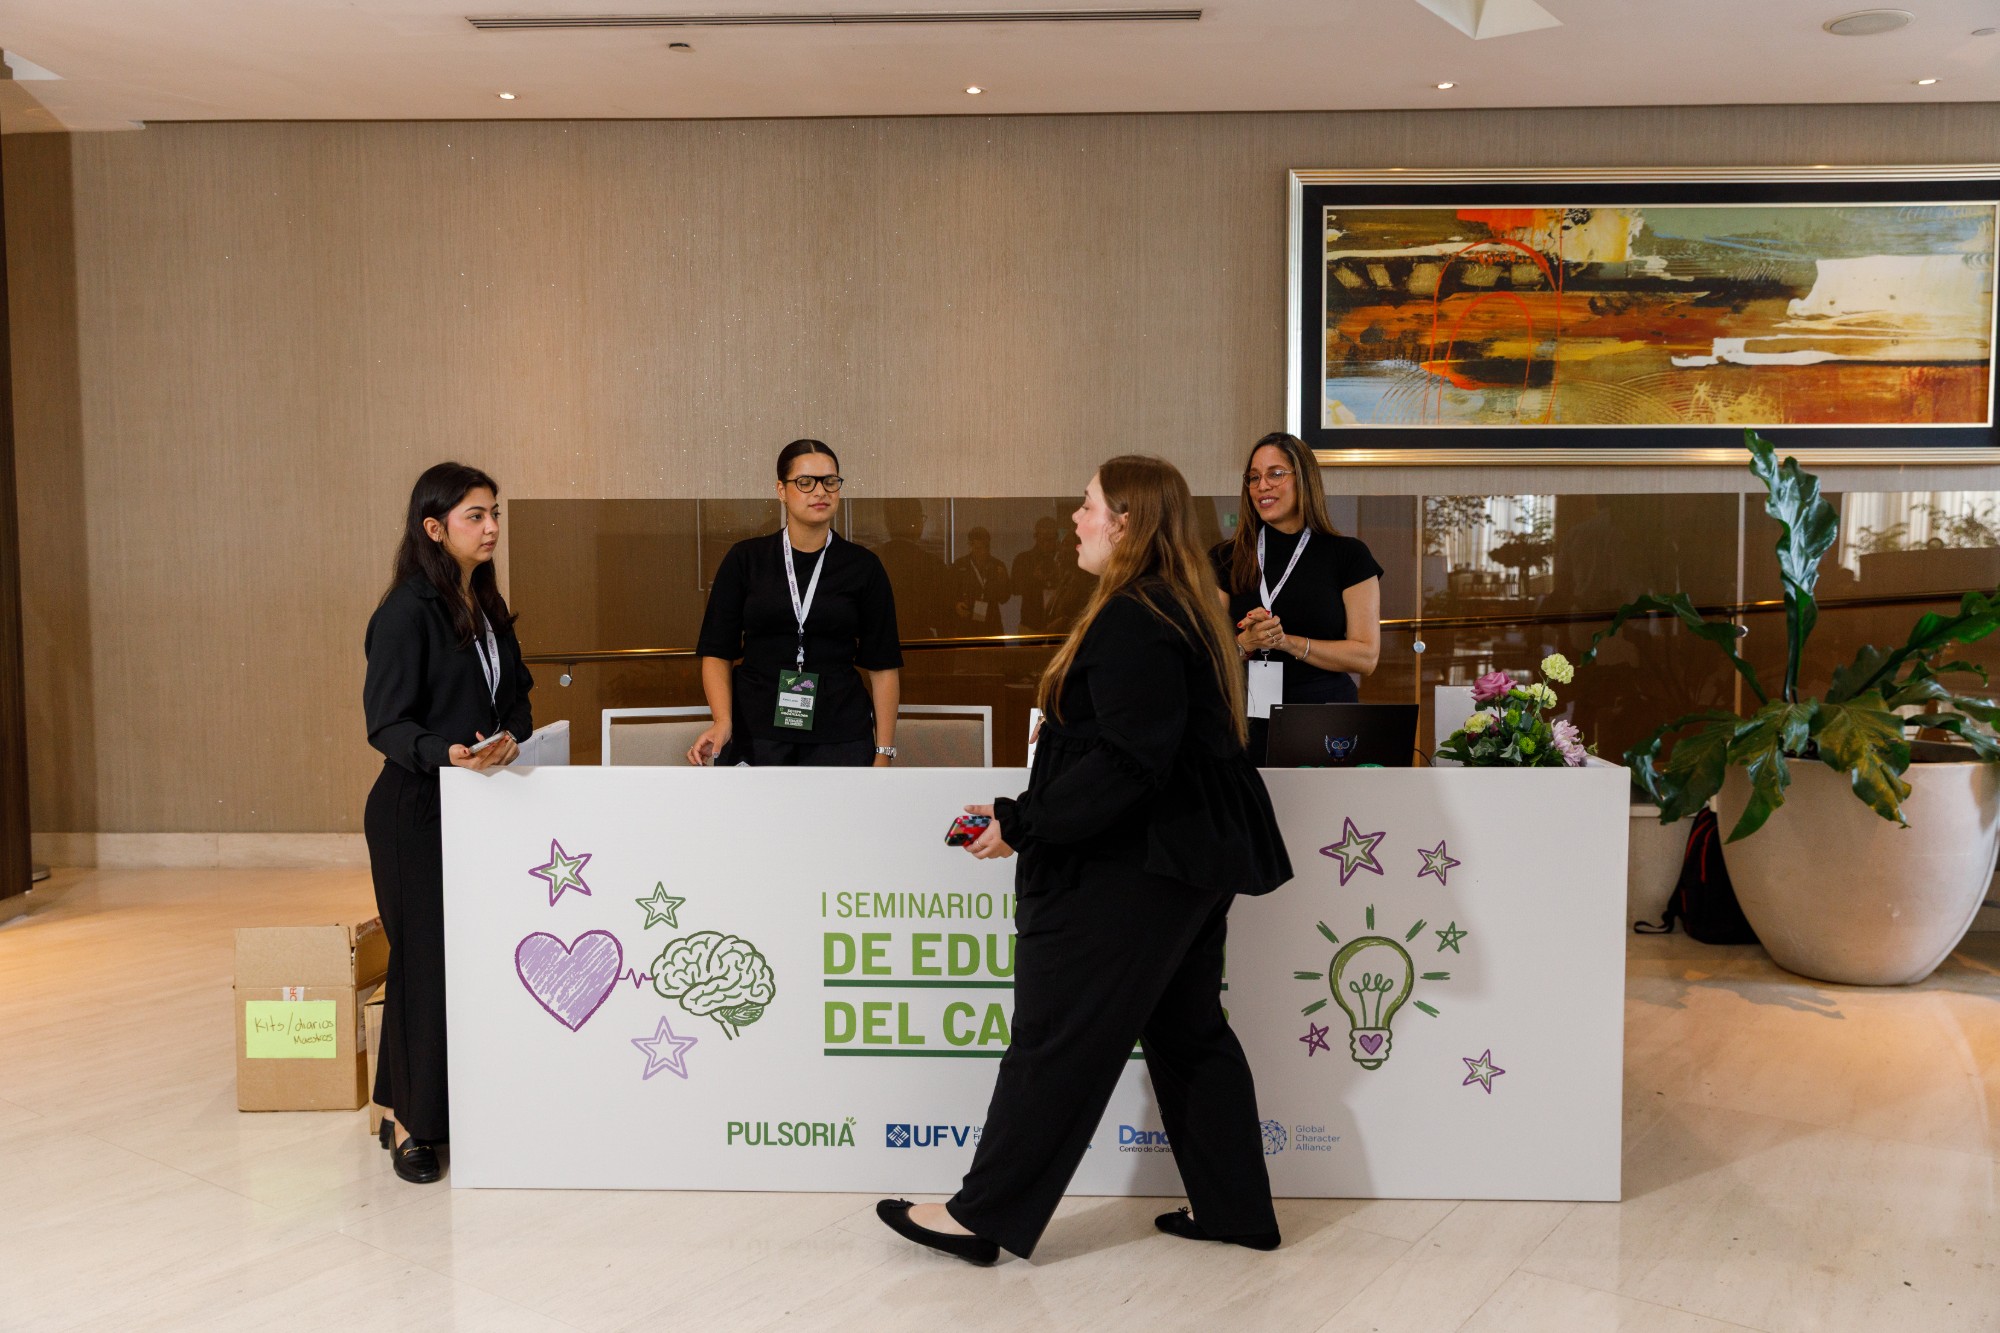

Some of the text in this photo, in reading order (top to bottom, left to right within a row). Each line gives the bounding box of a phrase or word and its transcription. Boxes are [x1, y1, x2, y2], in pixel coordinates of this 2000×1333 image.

[821, 891, 1017, 919] I SEMINARIO I
[823, 932, 892, 975] DE
[824, 1001, 925, 1045] DEL
[727, 1121, 855, 1147] PULSORIA
[913, 1125, 971, 1148] UFV
[1295, 1124, 1325, 1133] Global
[1295, 1134, 1341, 1143] Character
[1119, 1145, 1143, 1153] Centro
[1144, 1145, 1153, 1153] de
[1295, 1143, 1332, 1152] Alliance
